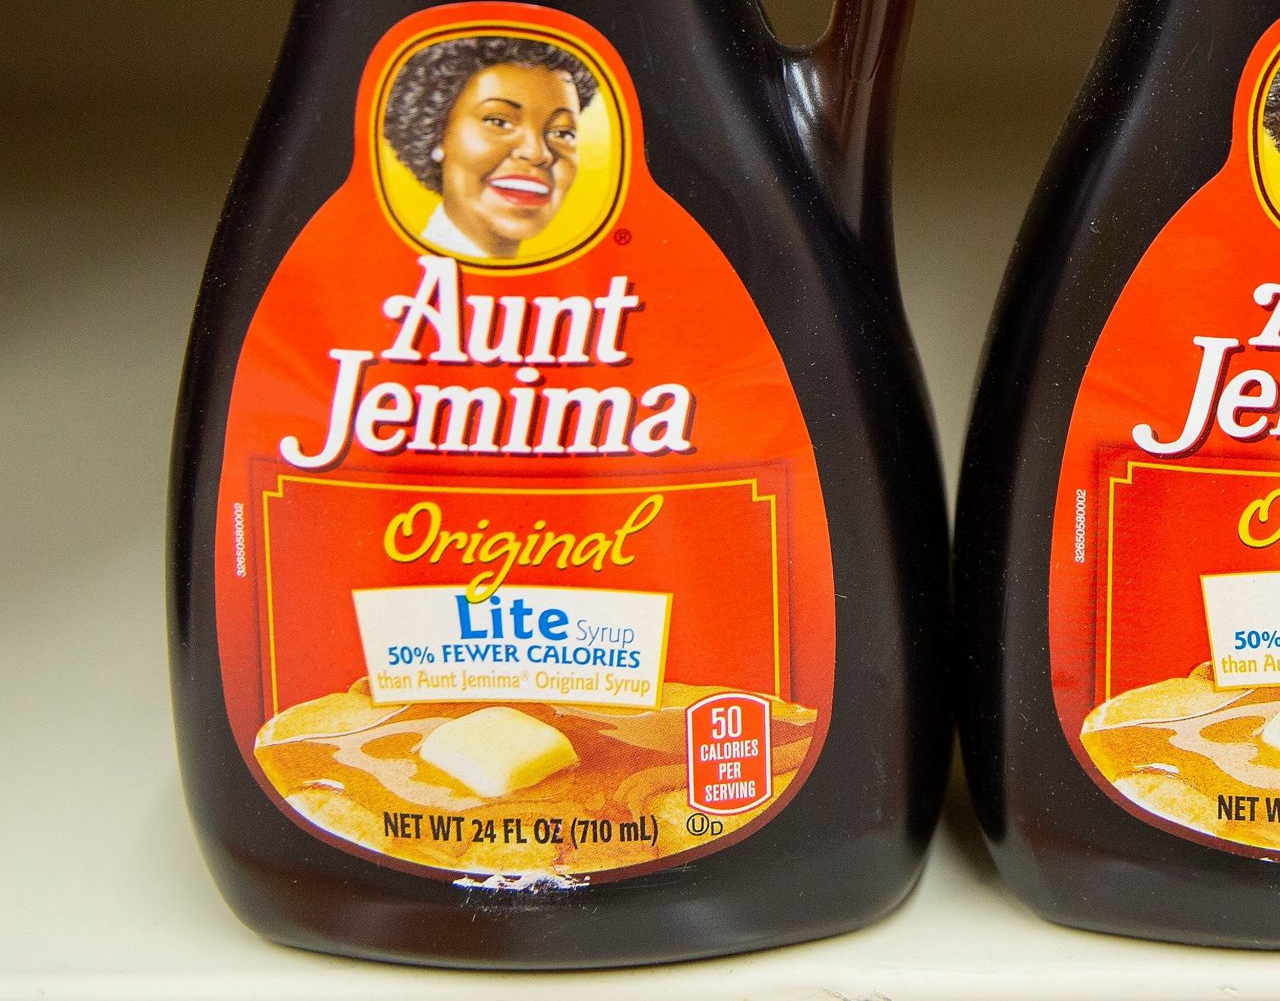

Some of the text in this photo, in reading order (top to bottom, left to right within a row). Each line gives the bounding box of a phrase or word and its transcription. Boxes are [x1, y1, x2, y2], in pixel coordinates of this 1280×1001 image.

[383, 256, 640, 367] Aunt
[279, 349, 698, 470] Jemima
[234, 502, 246, 578] 32650580002
[1075, 489, 1086, 563] 32650580002
[383, 494, 664, 602] Original
[455, 595, 634, 647] Lite Syrup
[388, 644, 641, 668] 50% FEWER CALORIES
[1222, 654, 1257, 672] than
[377, 671, 411, 689] than
[417, 670, 457, 689] Aunt
[536, 671, 598, 694] Original
[604, 673, 651, 697] Syrup
[711, 706, 742, 739] 50
[700, 737, 759, 762] CALORIES
[718, 761, 742, 782] PER
[704, 780, 757, 802] SERVING
[1217, 795, 1260, 820] NET
[384, 812, 659, 849] NET WT 24 FL OZ (710 mL)
